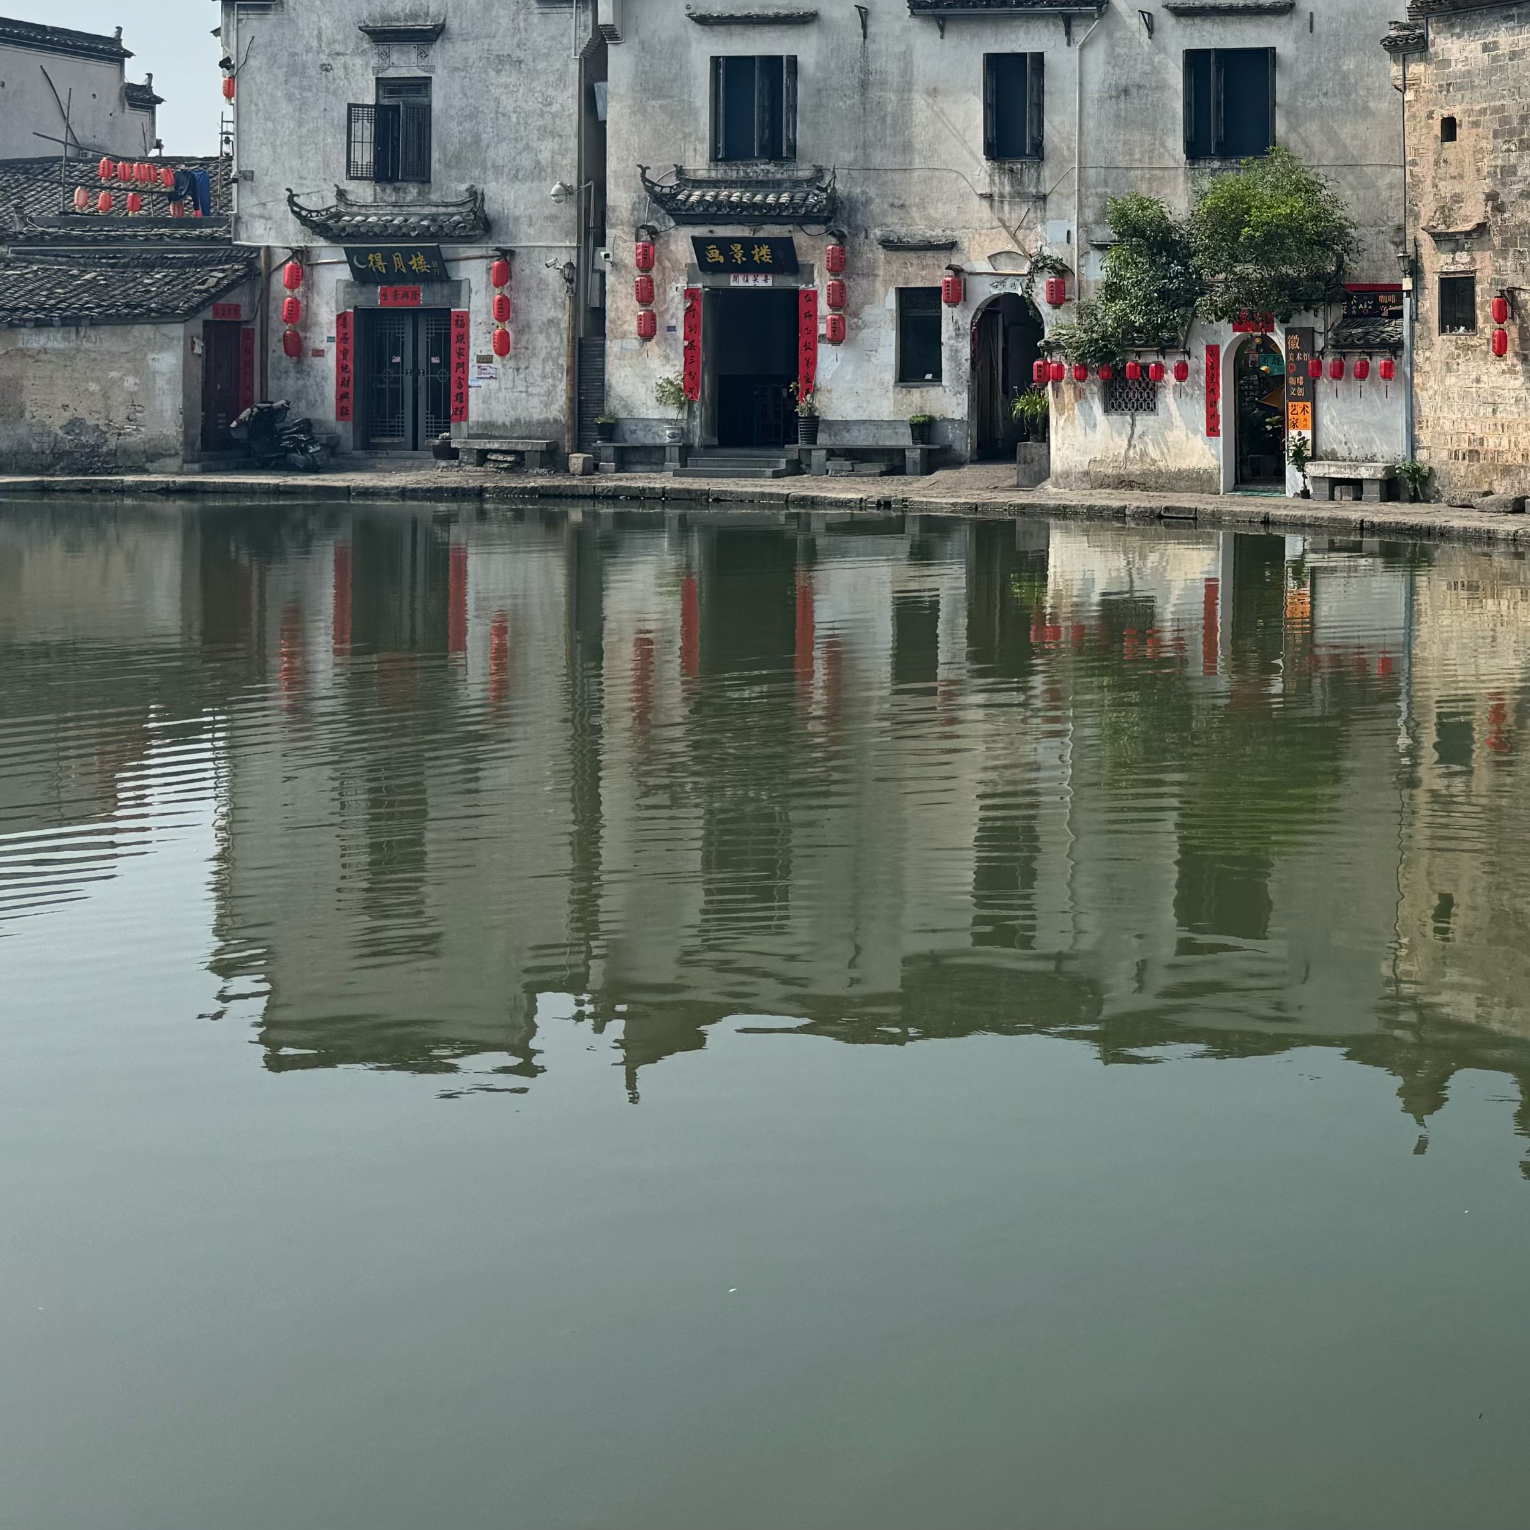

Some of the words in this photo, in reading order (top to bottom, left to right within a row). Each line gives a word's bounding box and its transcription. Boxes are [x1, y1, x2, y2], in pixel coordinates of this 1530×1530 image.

[705, 242, 773, 265] 画景楼
[367, 251, 432, 274] 得月楼
[1287, 334, 1300, 350] 徽
[1288, 351, 1310, 362] 美术馆
[1289, 386, 1305, 397] 文创
[1289, 403, 1310, 416] 艺术
[1289, 416, 1300, 430] 家
